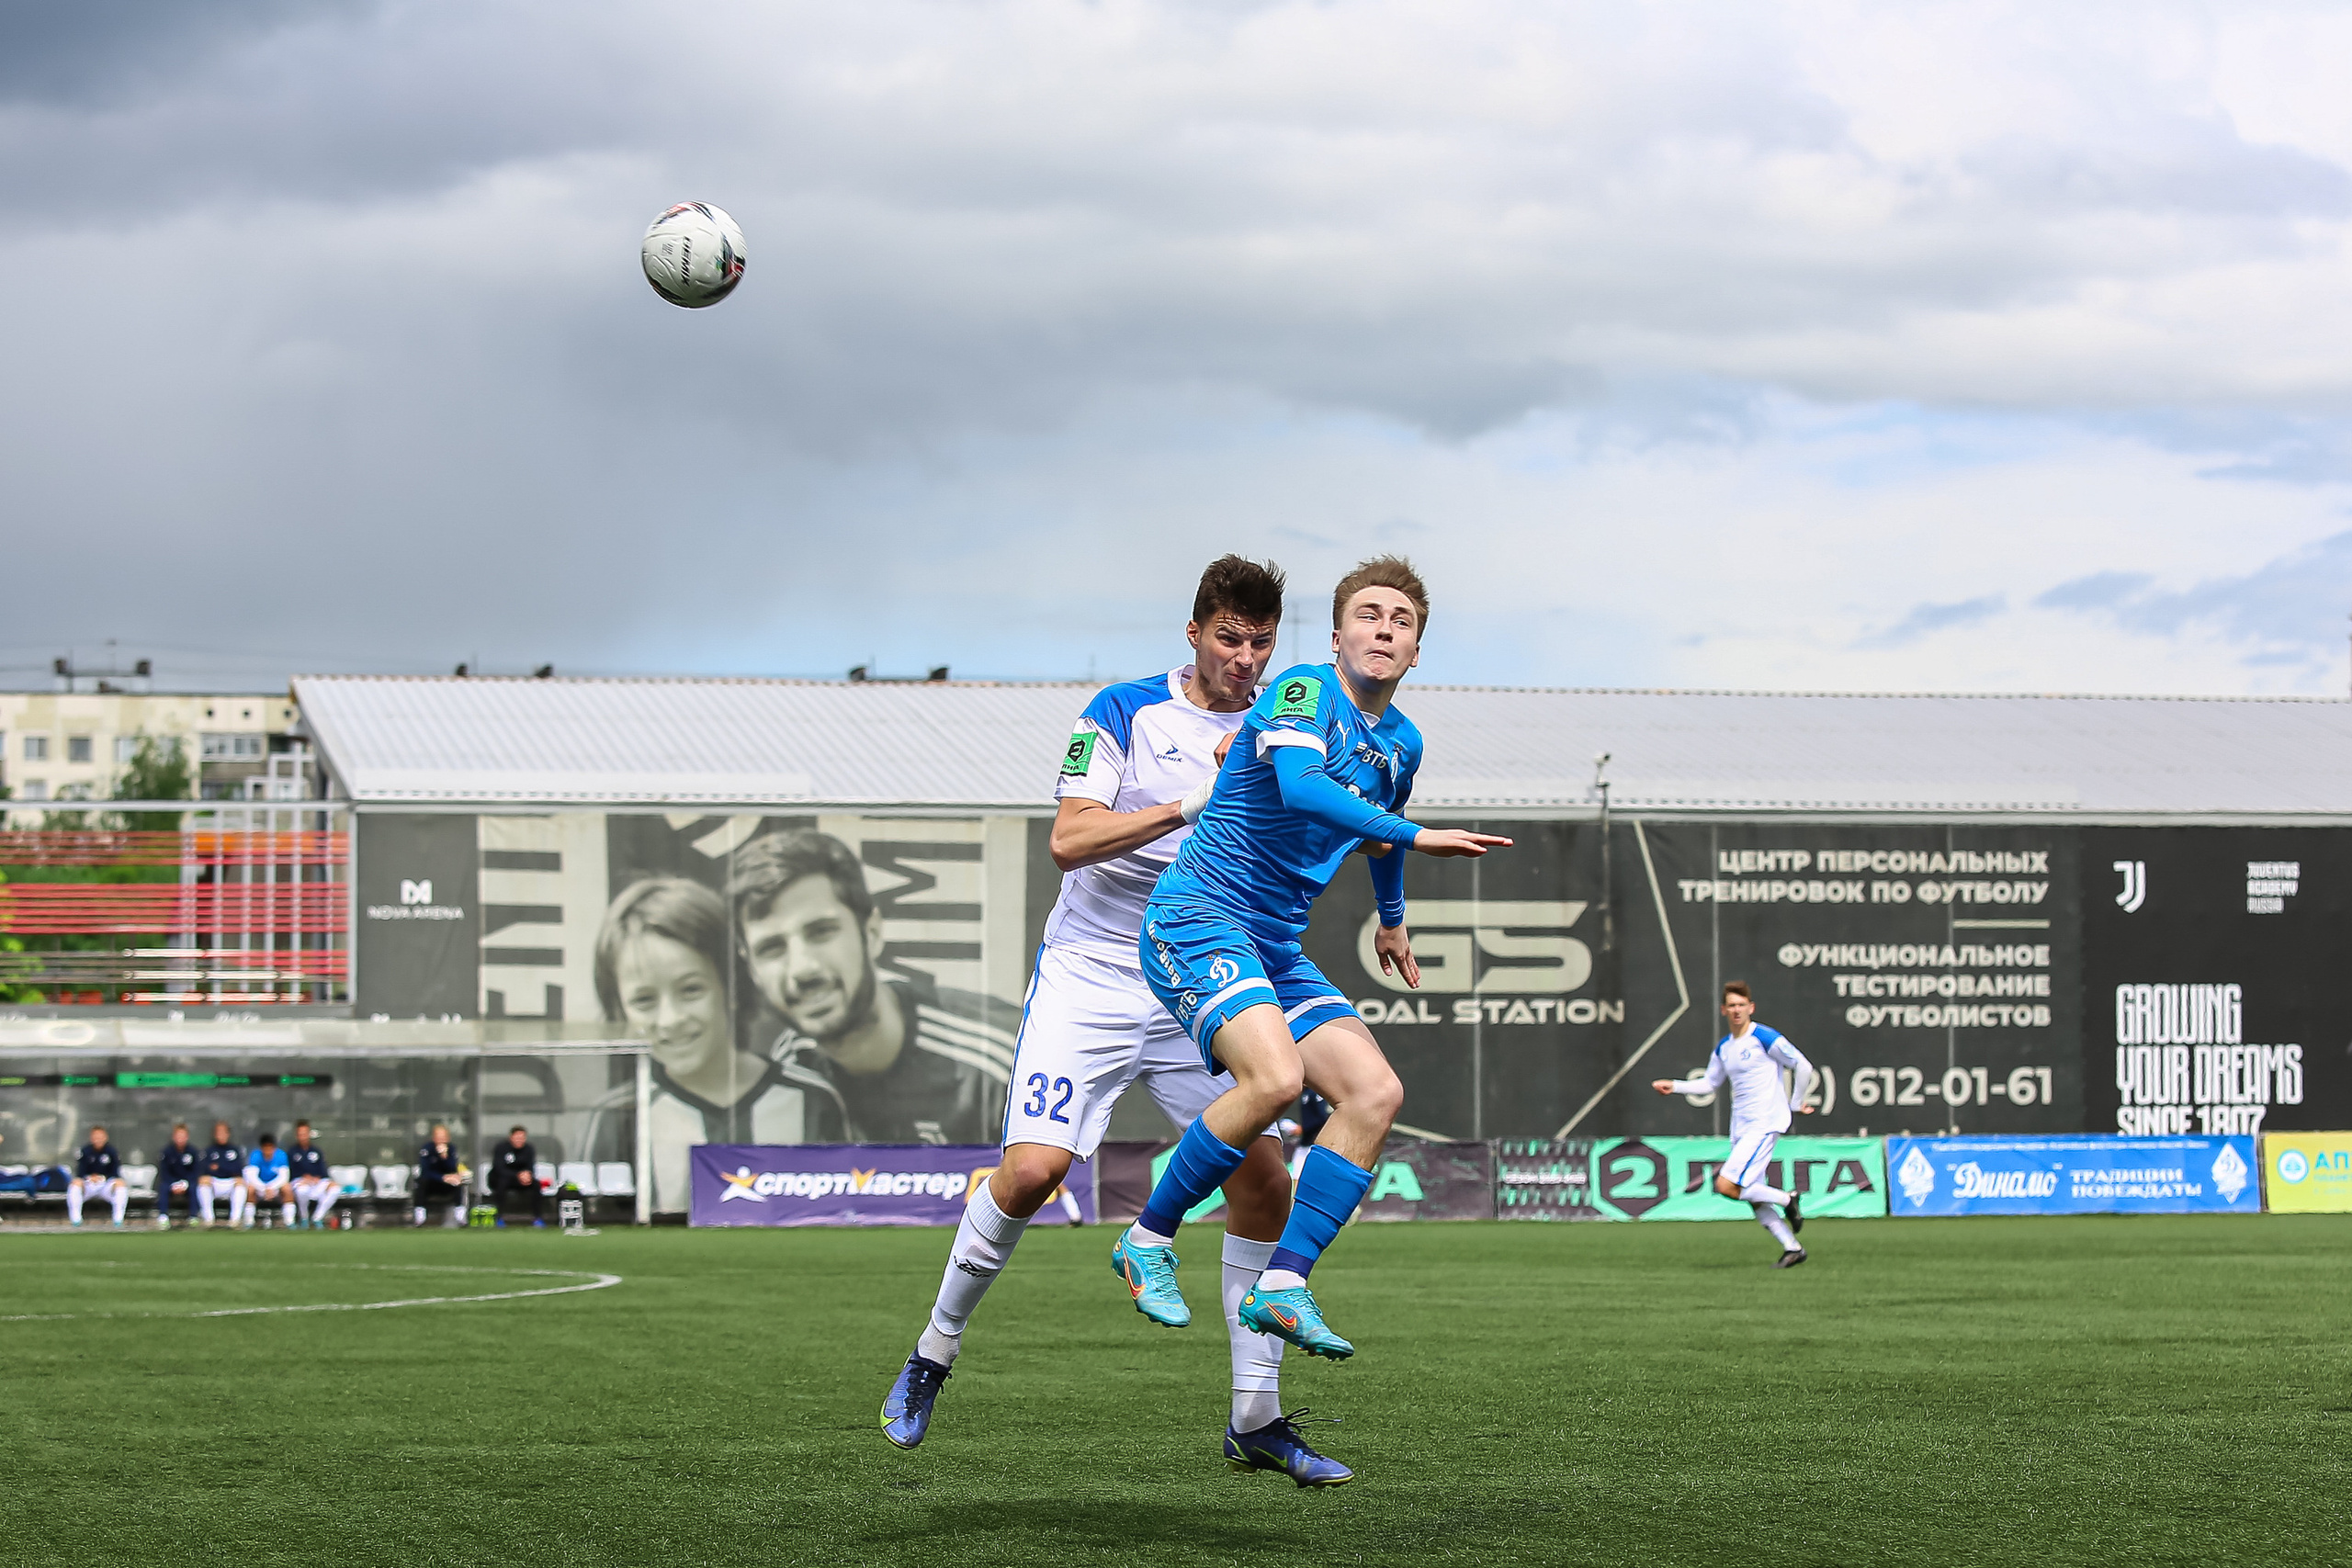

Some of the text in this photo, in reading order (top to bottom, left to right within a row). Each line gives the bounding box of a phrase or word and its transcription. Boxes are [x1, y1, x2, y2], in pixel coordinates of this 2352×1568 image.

[1288, 686, 1303, 699] 2
[1070, 745, 1083, 757] 2
[1156, 753, 1182, 762] DEMIX
[1361, 749, 1389, 769] ВТБ
[1718, 849, 2050, 874] ЦЕНТР ПЕРСОНАЛЬНЫХ
[1678, 879, 2050, 905] ТРЕНИРОВОК ПО ФУТБОЛУ
[1357, 899, 1593, 994] GS
[1778, 942, 2051, 969] ФУНКЦИОНАЛЬНОЕ
[1833, 975, 2051, 998] ТЕСТИРОВАНИЕ
[1350, 997, 1624, 1025] OAL STATION
[1845, 1004, 2052, 1028] ФУТБОЛИСТОВ
[2116, 983, 2243, 1045] GROWING
[1849, 1066, 2052, 1107] 612-01-61
[2116, 1043, 2304, 1106] YOUR DREAMS
[1023, 1072, 1075, 1125] 32
[2314, 1150, 2352, 1169] АП
[1609, 1155, 1660, 1199] 2
[2069, 1168, 2183, 1184] ТРАДИЦИИ
